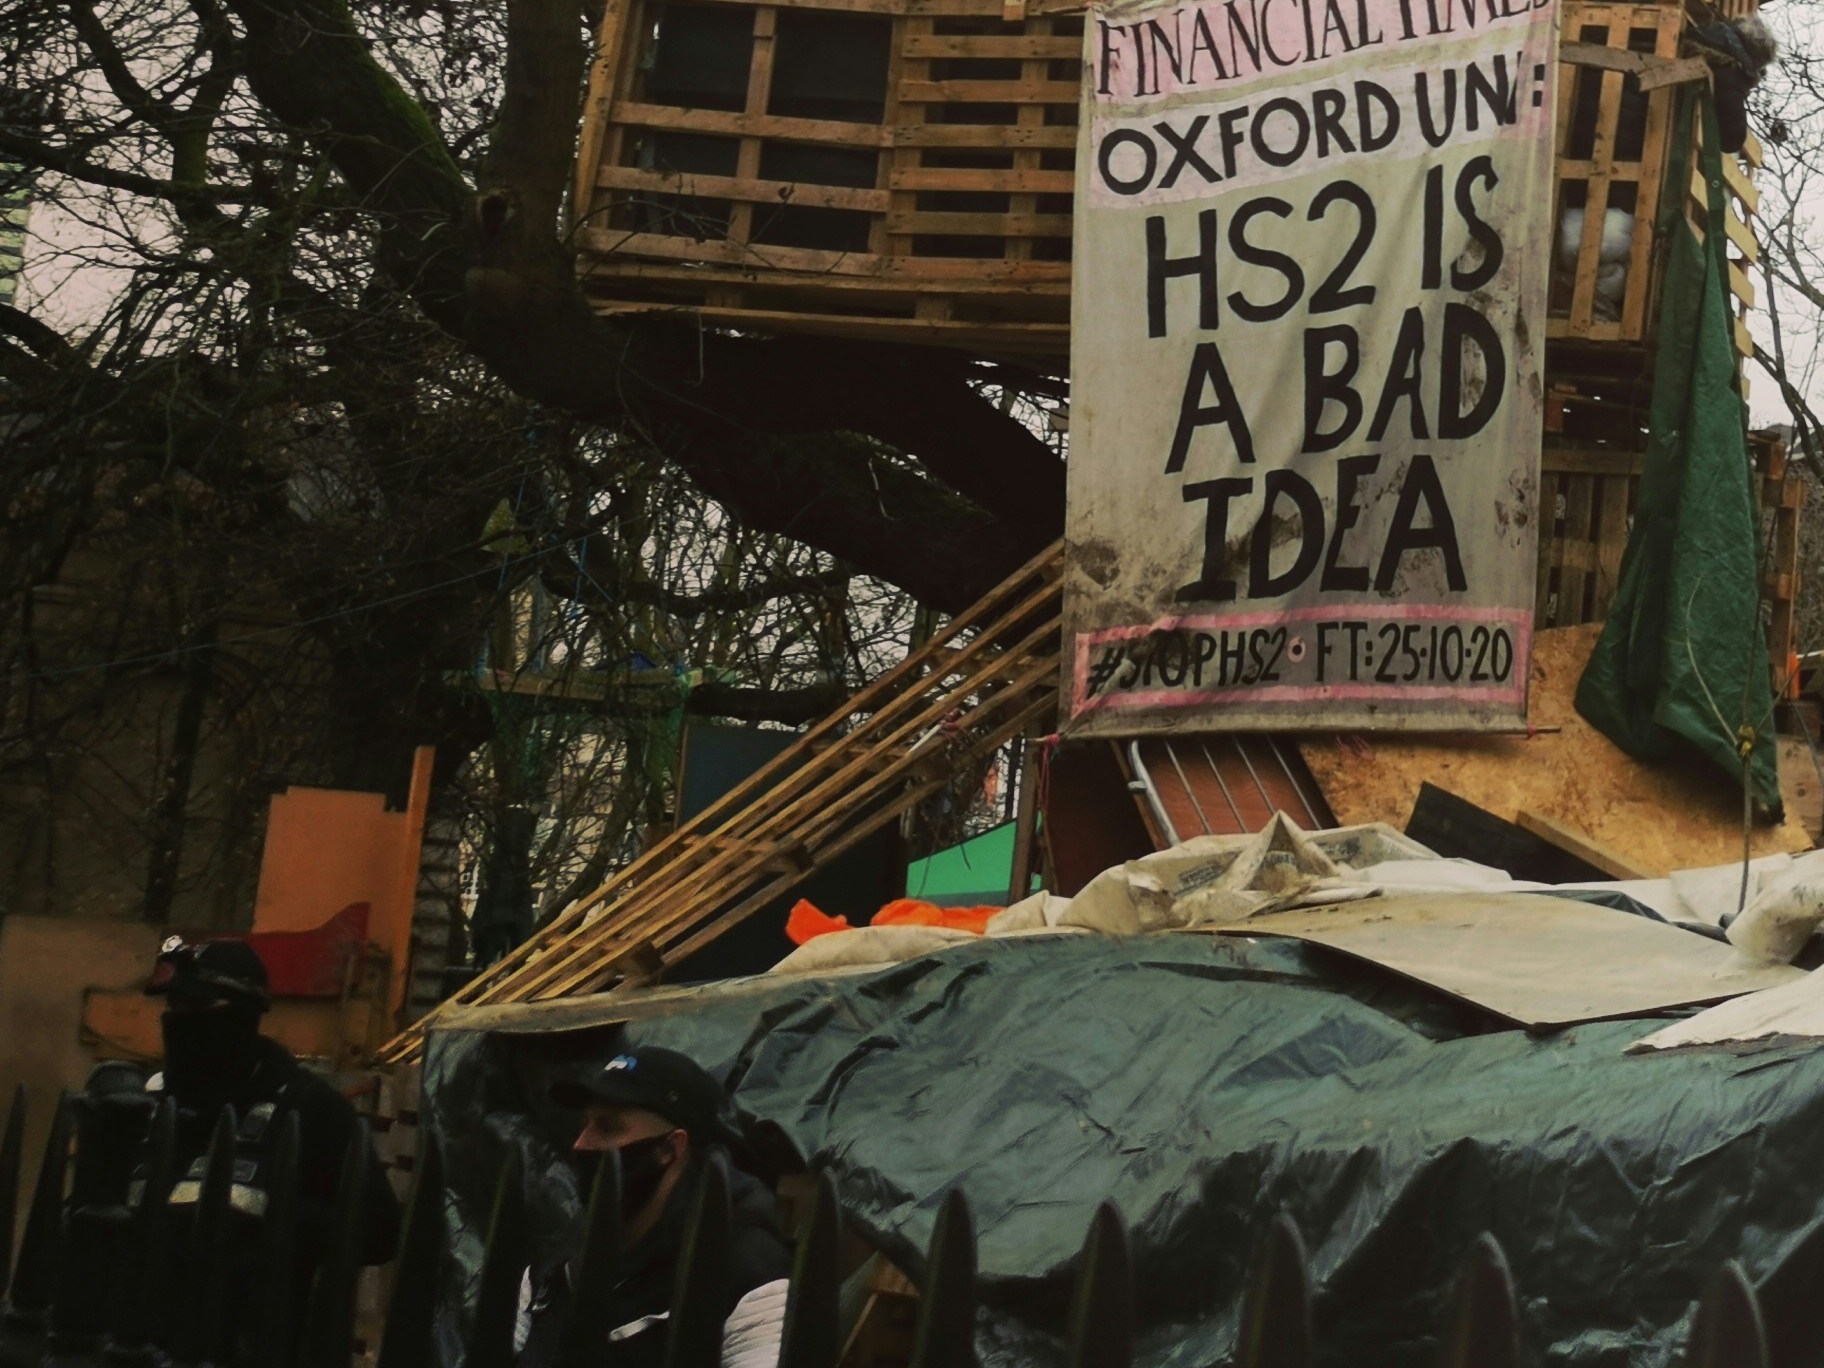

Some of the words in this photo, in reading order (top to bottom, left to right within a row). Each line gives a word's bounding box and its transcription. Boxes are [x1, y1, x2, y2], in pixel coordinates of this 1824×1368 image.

[1098, 80, 1400, 196] OXFORD
[1145, 180, 1377, 339] HS2
[1420, 155, 1505, 292] IS
[1164, 342, 1256, 474] A
[1301, 302, 1507, 454] BAD
[1175, 454, 1469, 603] IDEA
